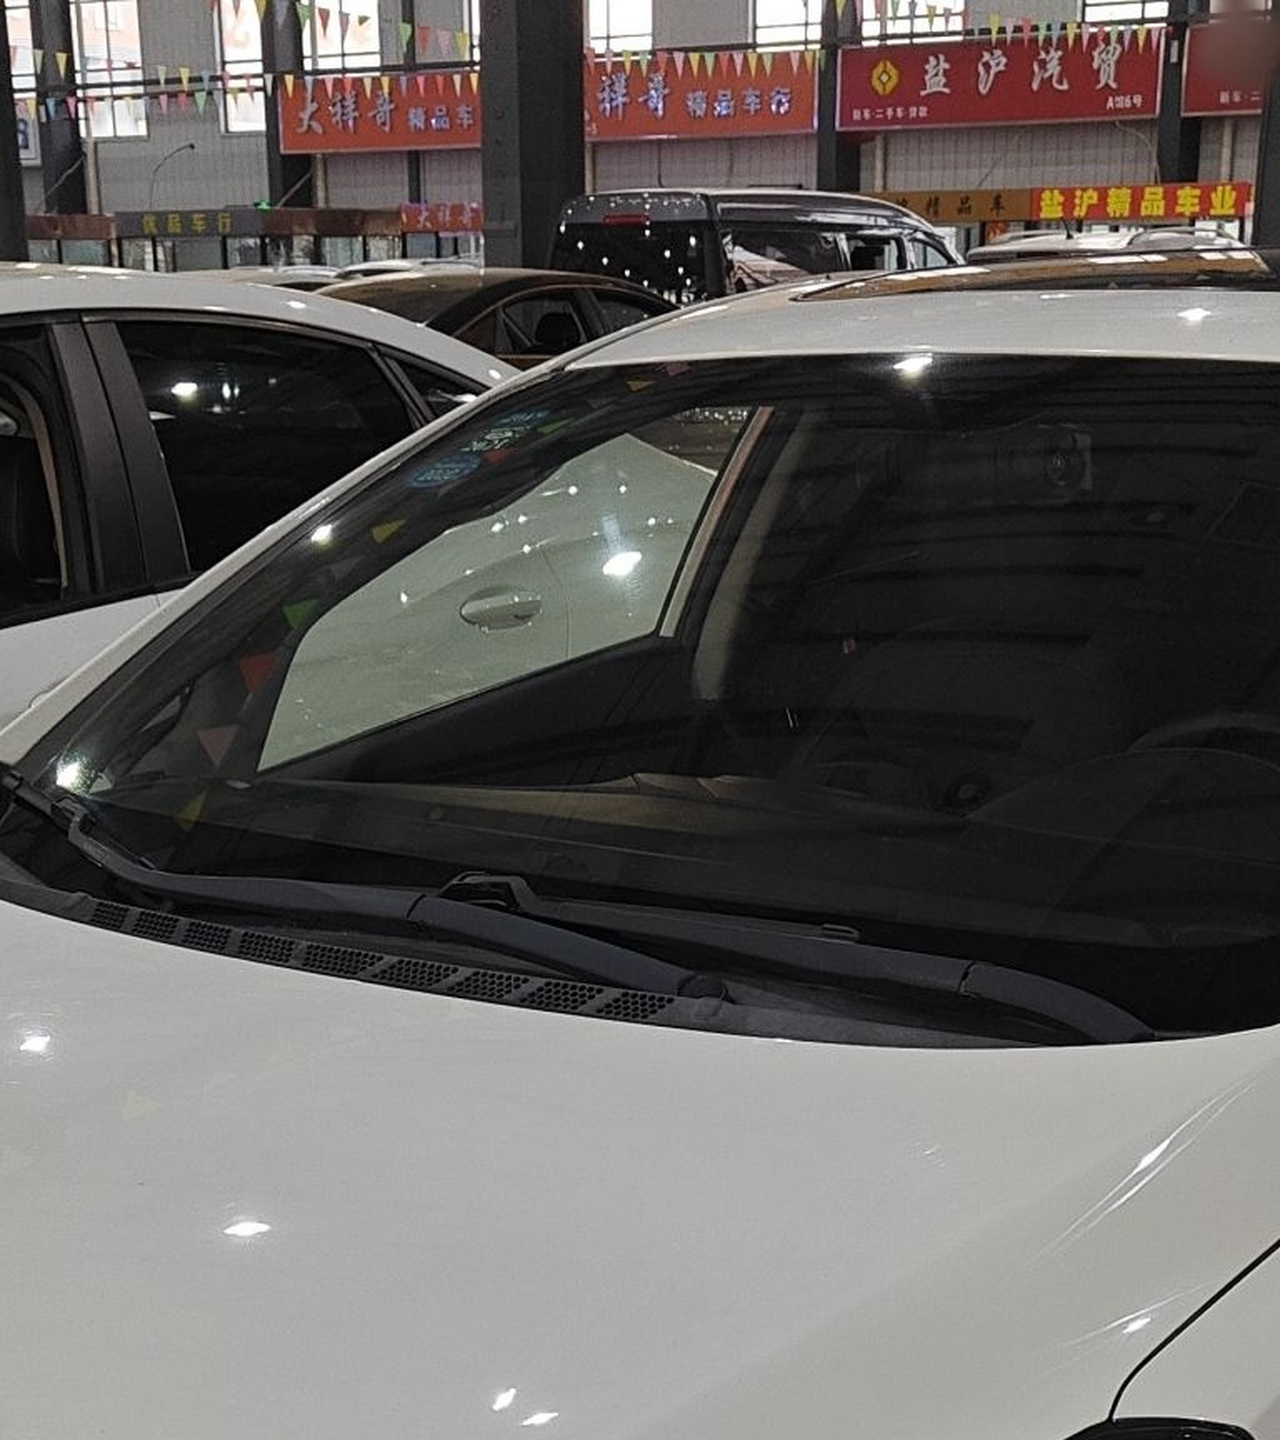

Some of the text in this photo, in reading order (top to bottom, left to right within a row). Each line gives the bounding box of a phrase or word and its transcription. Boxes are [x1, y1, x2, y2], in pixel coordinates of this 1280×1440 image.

[920, 44, 1122, 97] 盐沪汽贸
[1039, 186, 1237, 219] 盐沪精品车业
